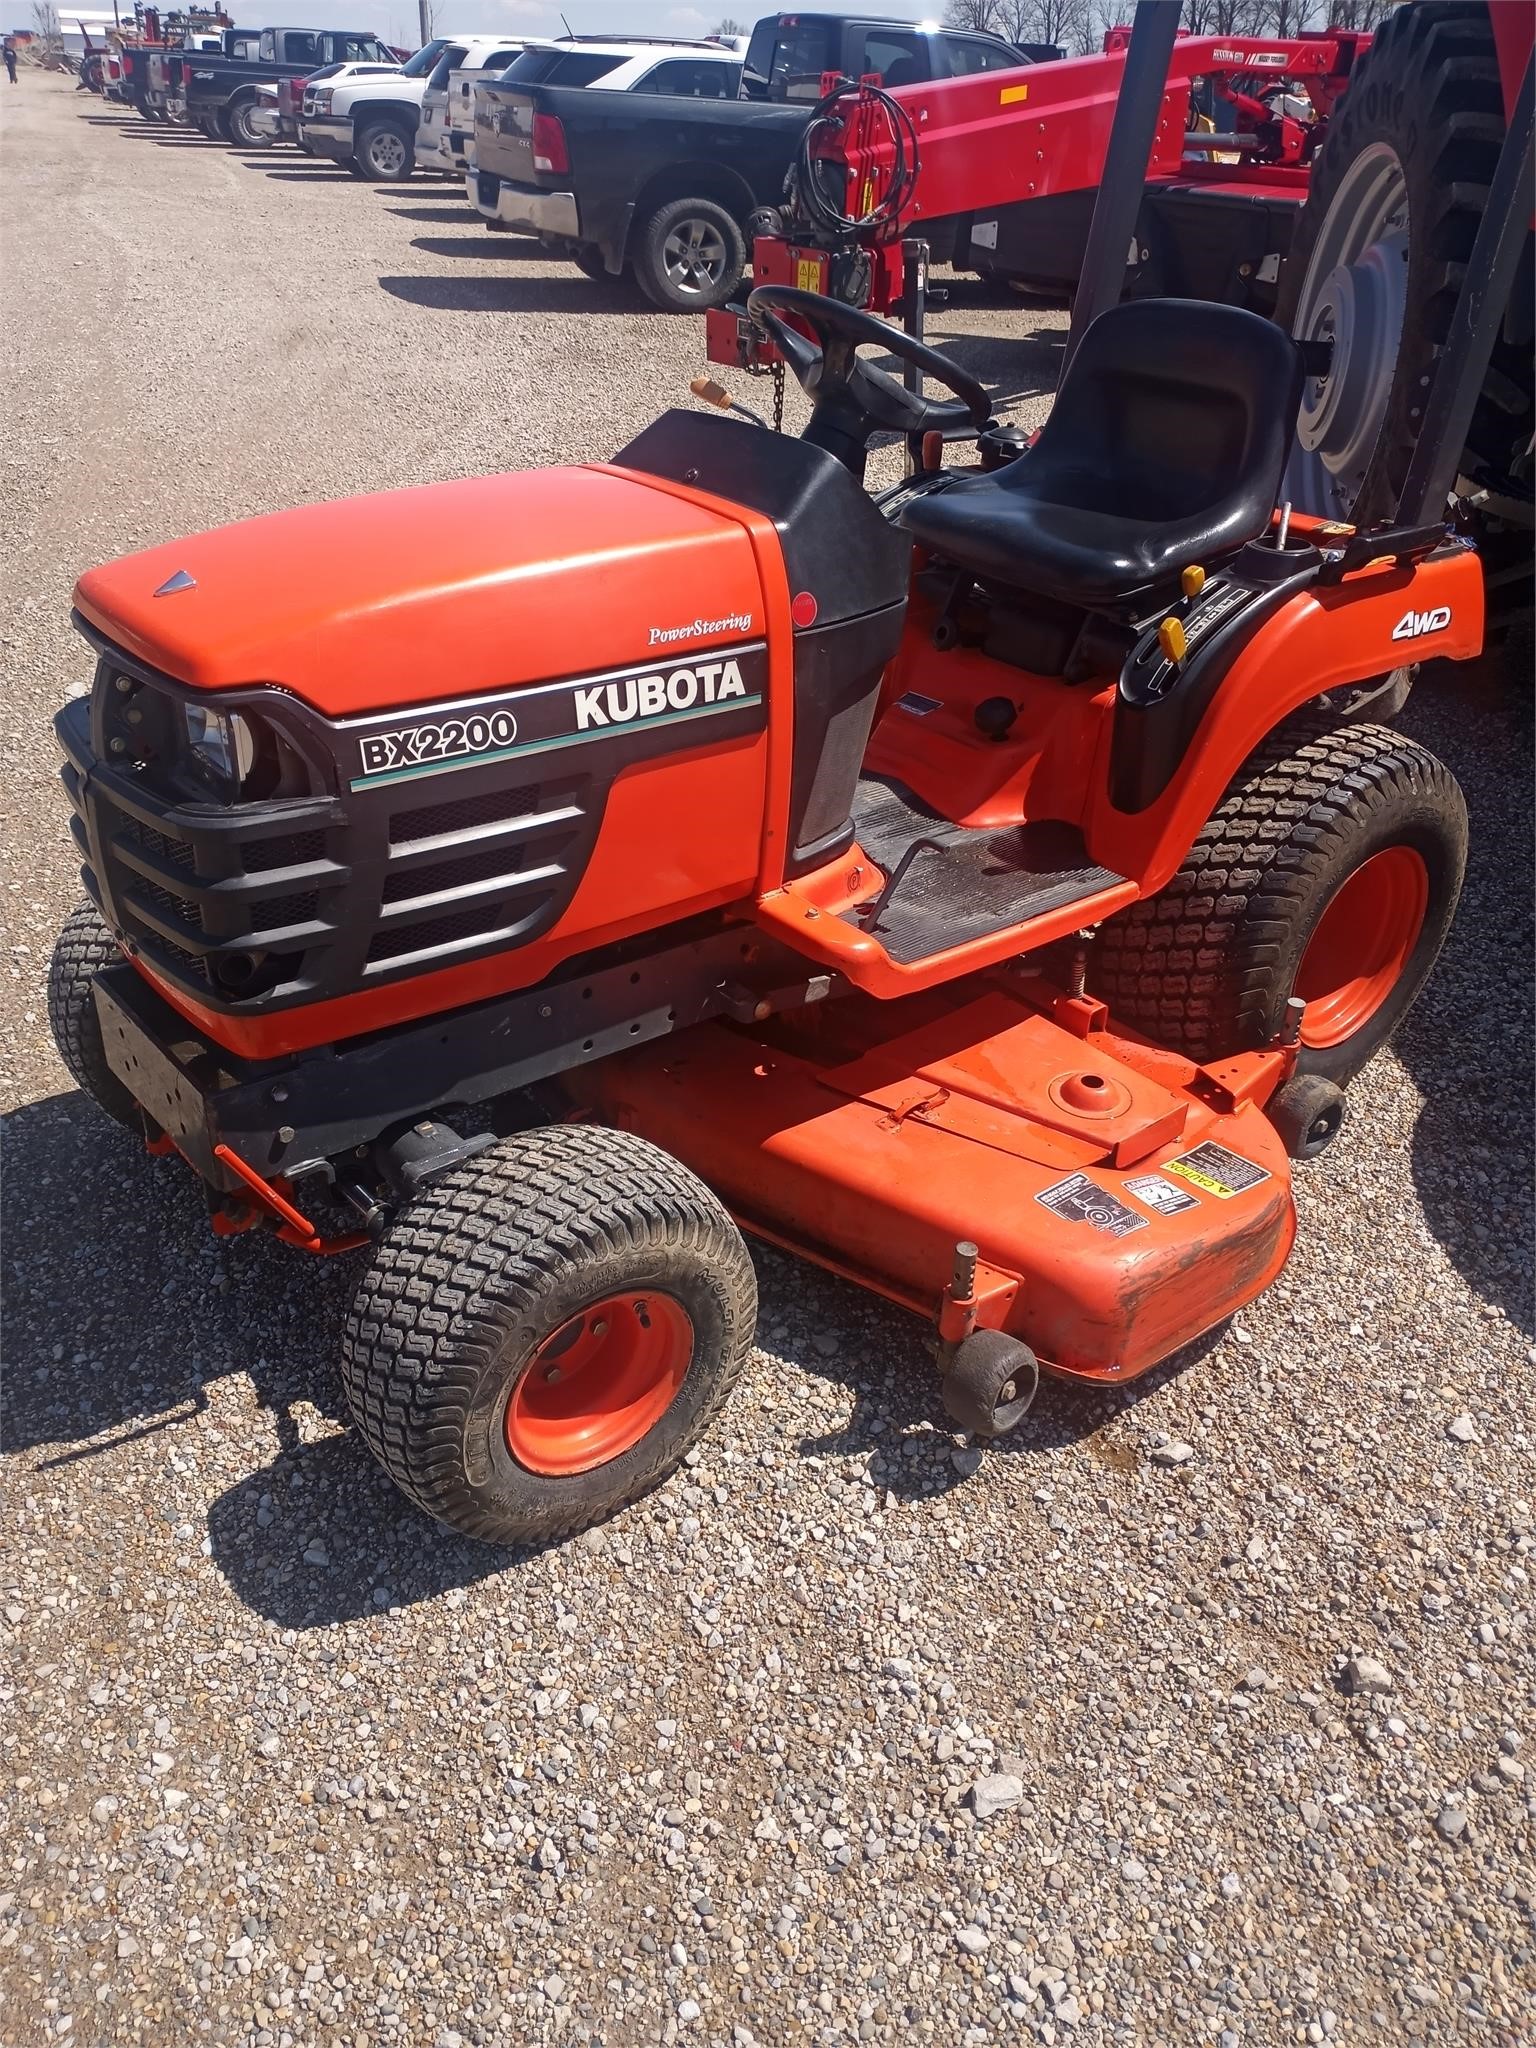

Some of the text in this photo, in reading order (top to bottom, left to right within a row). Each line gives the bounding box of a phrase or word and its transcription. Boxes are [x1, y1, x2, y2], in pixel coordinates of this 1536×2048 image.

[1391, 606, 1452, 641] 4WD
[574, 659, 746, 730] KUBOTA
[360, 710, 517, 774] BX2200
[1167, 1163, 1215, 1188] CAUTION
